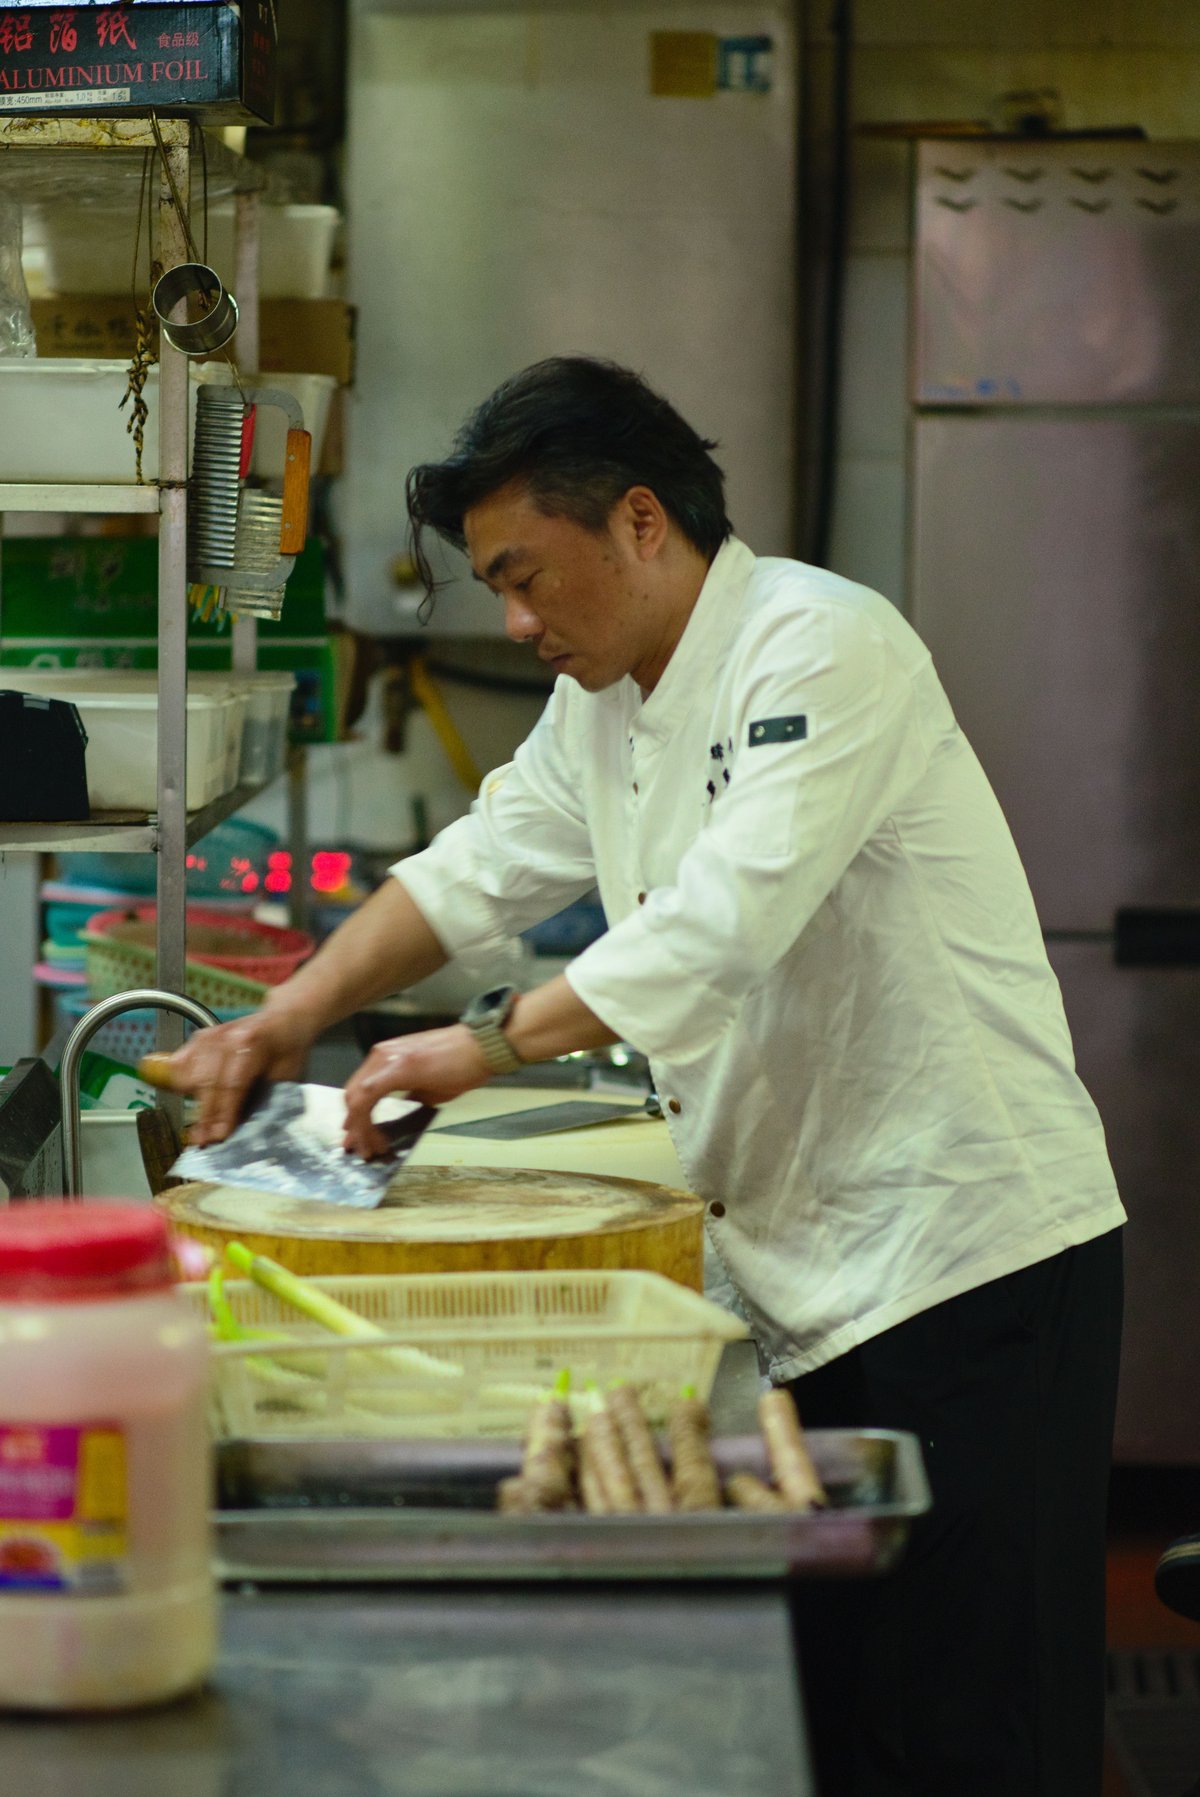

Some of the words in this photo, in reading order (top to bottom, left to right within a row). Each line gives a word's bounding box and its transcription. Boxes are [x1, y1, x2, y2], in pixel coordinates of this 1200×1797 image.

[0, 8, 136, 53] 铝箔纸
[157, 32, 199, 48] 食品级
[0, 62, 143, 89] ALUMINIUM
[150, 60, 208, 82] FOIL
